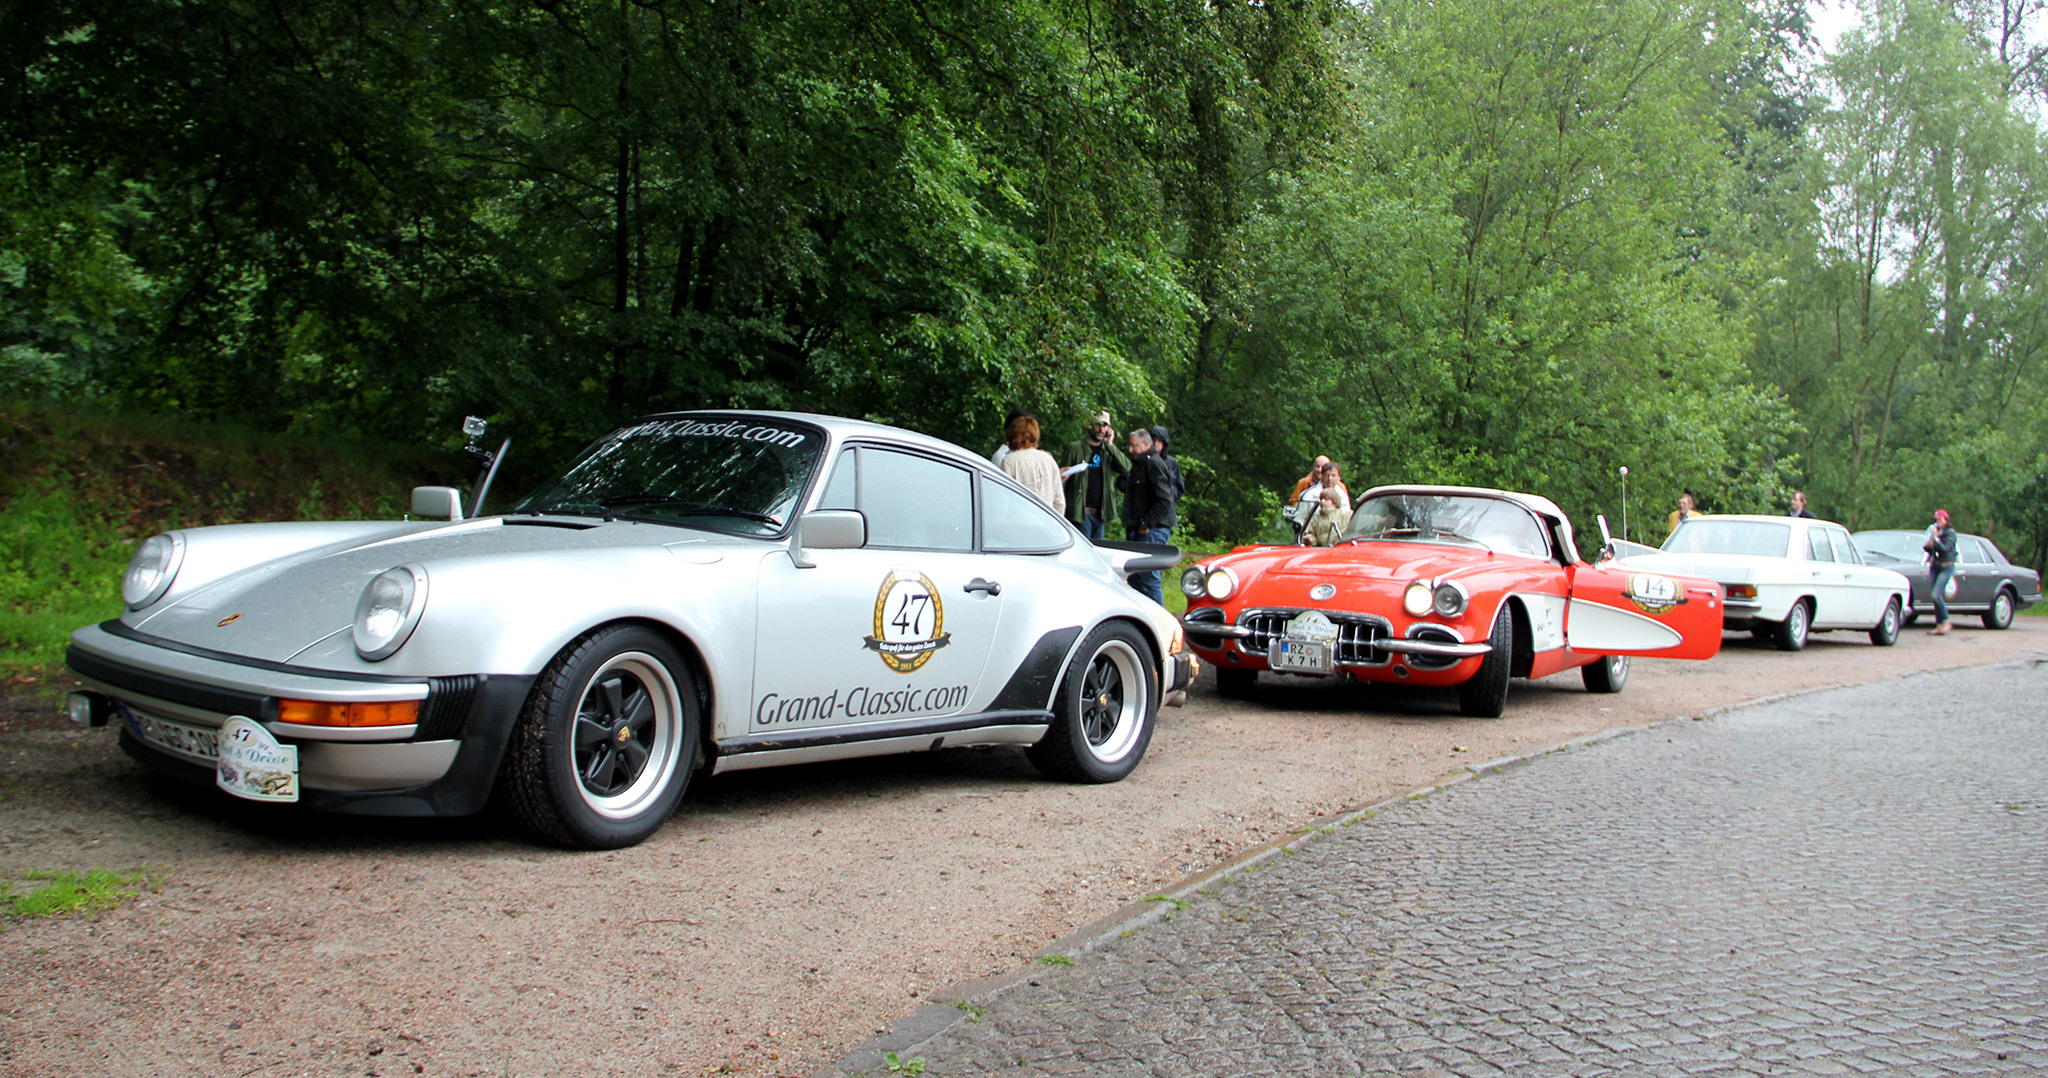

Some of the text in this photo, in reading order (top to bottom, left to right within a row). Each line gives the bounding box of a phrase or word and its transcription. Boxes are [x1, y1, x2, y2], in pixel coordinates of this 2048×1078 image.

[1643, 577, 1667, 596] 14
[891, 593, 930, 635] 47
[1290, 644, 1304, 654] RZ
[1288, 655, 1317, 666] K 7 H
[756, 683, 968, 725] Grand-Classic.com
[232, 728, 252, 742] 47
[245, 748, 290, 764] Drive
